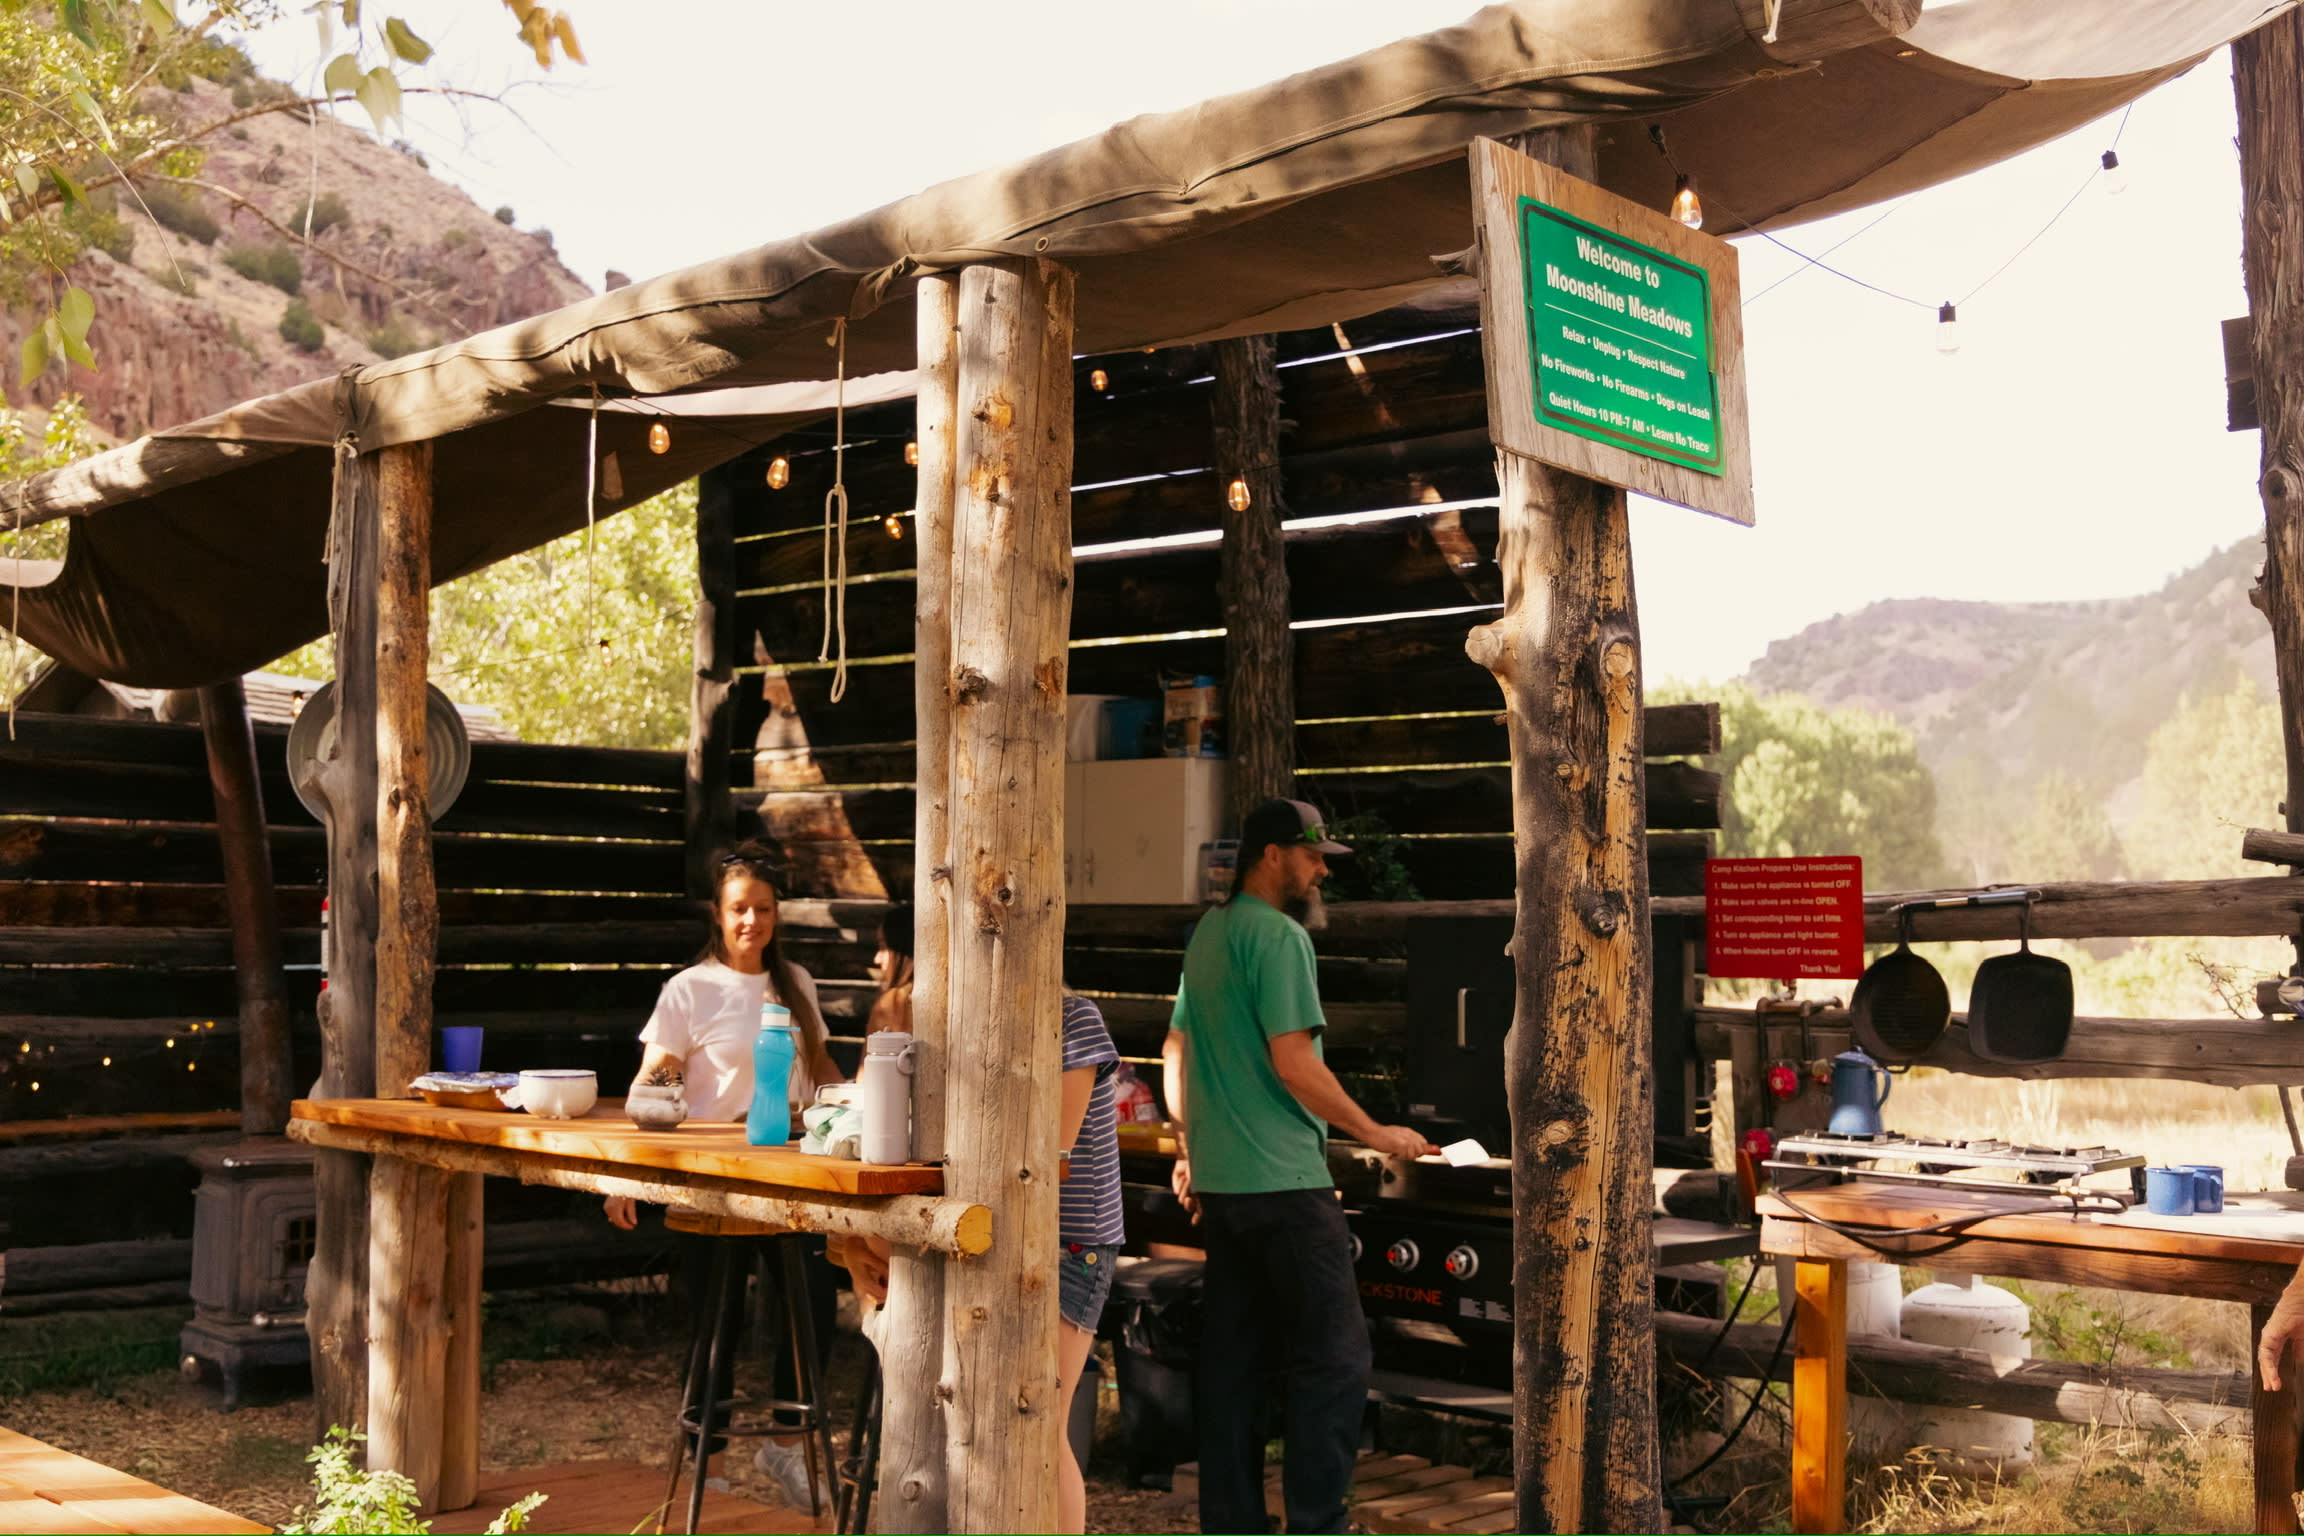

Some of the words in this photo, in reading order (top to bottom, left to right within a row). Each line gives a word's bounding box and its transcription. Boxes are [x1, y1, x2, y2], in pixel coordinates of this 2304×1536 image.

[1576, 236, 1642, 282] Welcome
[1645, 266, 1659, 288] to
[1546, 263, 1625, 313] Moonshine
[1628, 294, 1693, 338] Meadows
[1562, 326, 1585, 345] Relax
[1593, 336, 1621, 360] Unplug
[1627, 349, 1659, 370] Respect
[1660, 360, 1685, 379] Nature
[1542, 353, 1553, 368] No
[1555, 358, 1595, 382] Fireworks
[1602, 374, 1613, 388] No
[1615, 378, 1650, 401] Firearms
[1656, 393, 1675, 411] Dogs
[1677, 402, 1686, 412] on
[1687, 403, 1710, 420] Leash
[1549, 392, 1571, 410] Quiet
[1573, 400, 1596, 418] Hours
[1599, 408, 1608, 422] 10
[1610, 411, 1630, 428] PM-7
[1632, 419, 1645, 433] AM
[1651, 425, 1674, 443] Leave
[1676, 432, 1686, 446] No
[1687, 437, 1709, 453] Trace
[1712, 865, 1732, 874] Camp
[1761, 864, 1791, 873] Propane
[1808, 863, 1854, 871] Instructions:
[1769, 881, 1802, 890] appliance
[1835, 880, 1851, 888] OFF.
[1815, 896, 1839, 904] OPEN.
[1734, 915, 1783, 924] corresponding
[1798, 931, 1813, 940] light
[1800, 964, 1822, 972] Thank
[1359, 1281, 1443, 1305] CKSTONE
